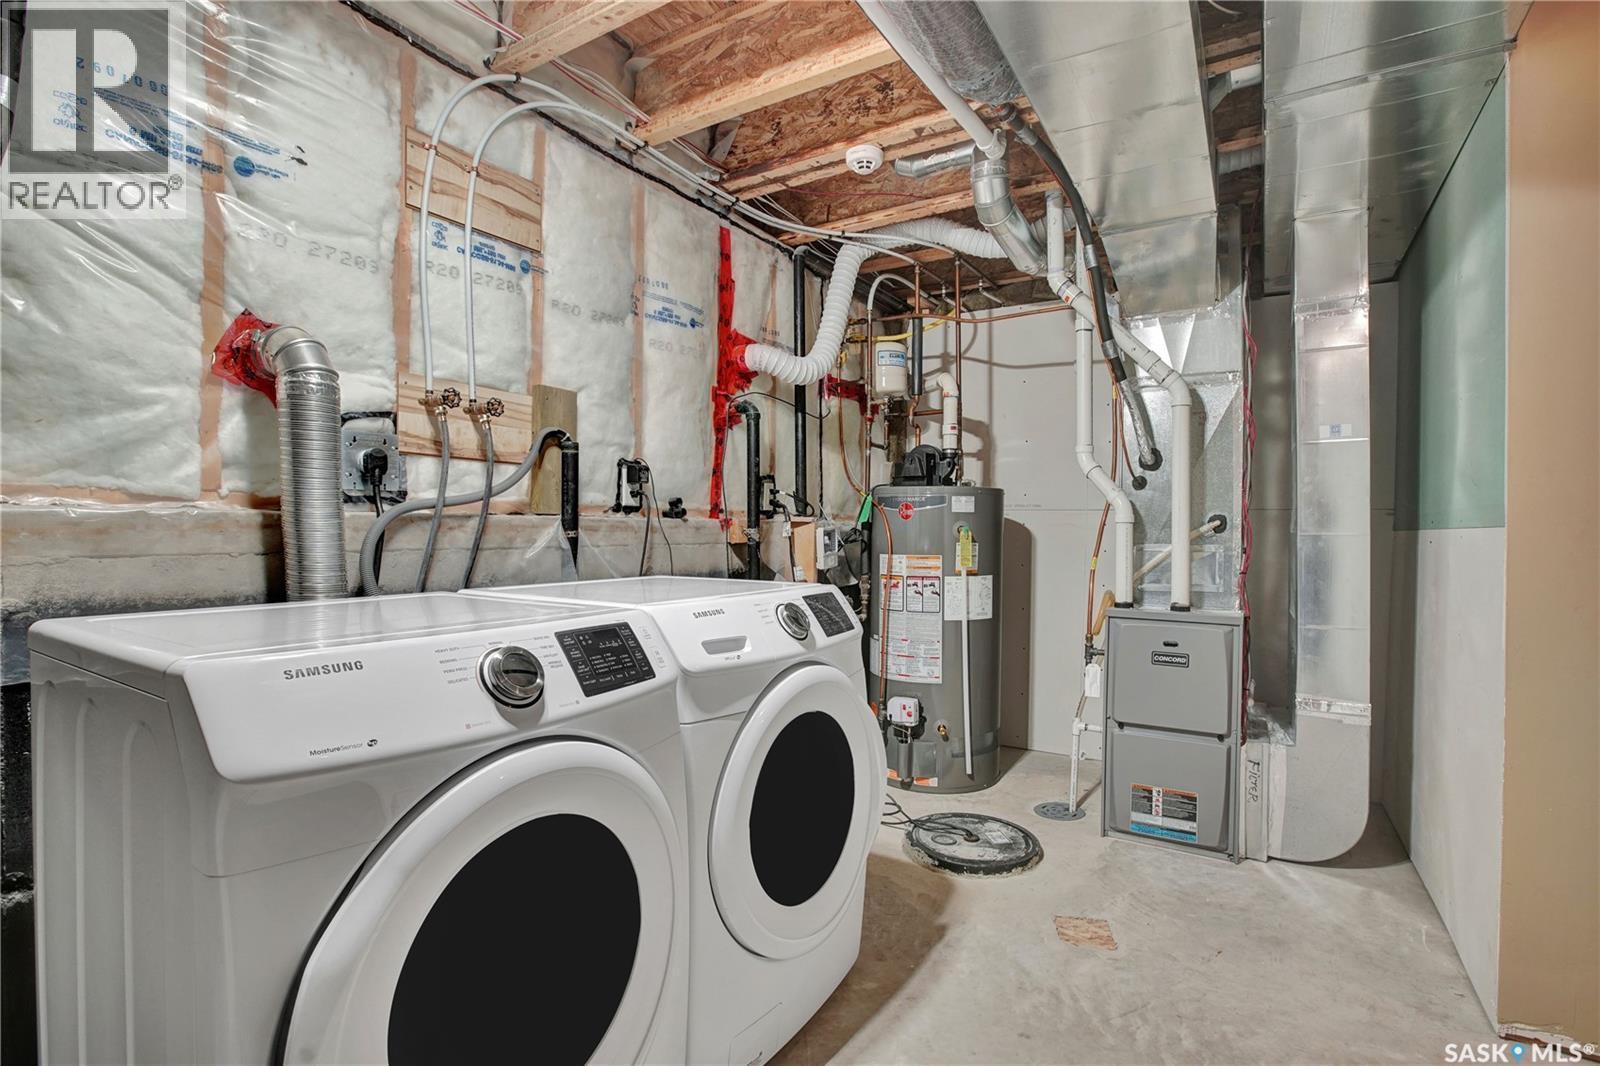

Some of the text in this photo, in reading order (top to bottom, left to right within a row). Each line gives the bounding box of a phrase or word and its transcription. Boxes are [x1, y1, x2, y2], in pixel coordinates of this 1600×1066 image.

[693, 608, 725, 619] SAMSUNG
[1153, 654, 1187, 665] CONCORD
[283, 660, 364, 680] SAMSUNG
